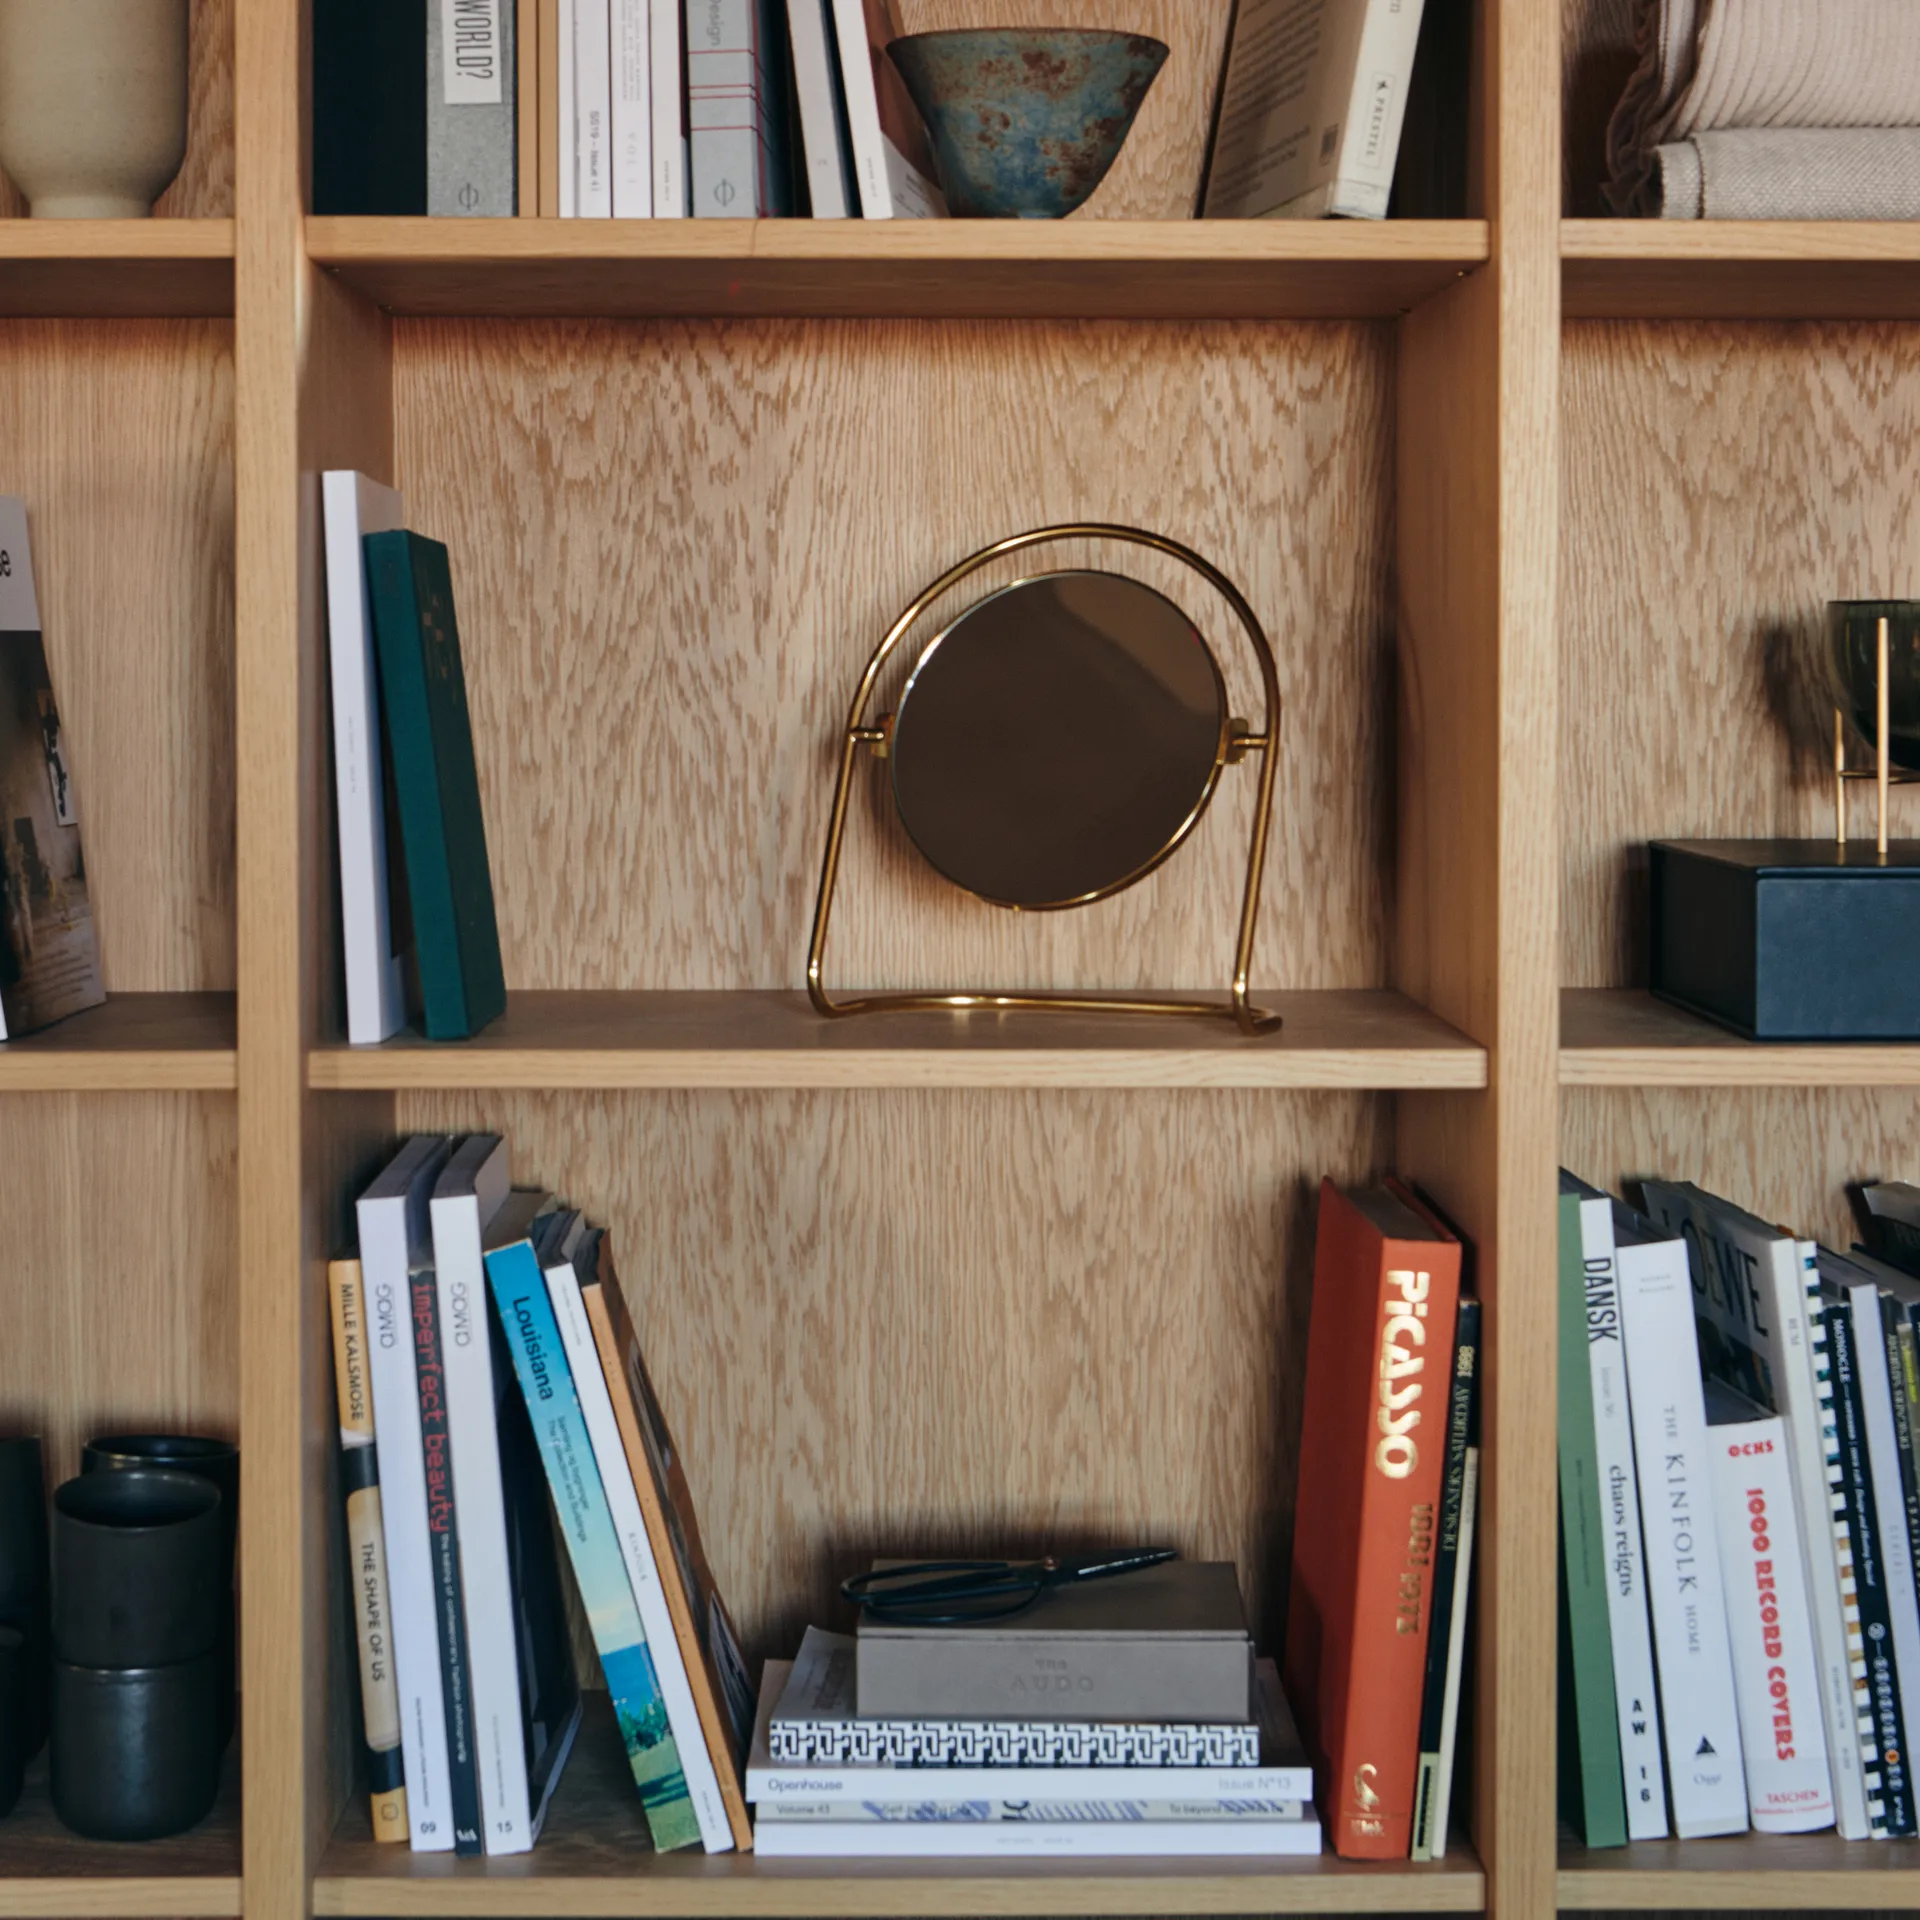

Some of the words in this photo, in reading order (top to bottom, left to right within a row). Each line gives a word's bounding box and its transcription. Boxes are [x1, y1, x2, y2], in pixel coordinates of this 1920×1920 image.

[455, 0, 494, 79] WORLD?
[1583, 1258, 1618, 1342] DANSK
[1661, 1208, 1769, 1337] OEWE
[340, 1284, 359, 1328] MILLE
[346, 1334, 364, 1420] KALSMOSE
[413, 1284, 443, 1423] imperfect
[514, 1297, 555, 1401] Louisiana
[1832, 1318, 1853, 1382] MONOCLE
[1448, 1385, 1471, 1462] SATURDAY
[1663, 1405, 1678, 1440] THE
[426, 1434, 452, 1532] beauty
[1608, 1464, 1629, 1525] chaos
[1665, 1453, 1698, 1594] KINFOLK
[1746, 1488, 1771, 1553] 1000
[362, 1543, 377, 1572] THE
[1612, 1531, 1635, 1596] reigns
[364, 1578, 381, 1629] SHAPE
[1685, 1605, 1701, 1655] HOME
[1754, 1560, 1783, 1659] RECORD
[370, 1634, 382, 1656] OF
[372, 1662, 385, 1681] US
[1768, 1666, 1795, 1761] COVERS
[768, 1779, 843, 1793] Openhouse
[776, 1804, 814, 1815] Volume
[1766, 1790, 1819, 1804] TASCHEN
[420, 1822, 436, 1833] 09
[496, 1821, 513, 1833] 15
